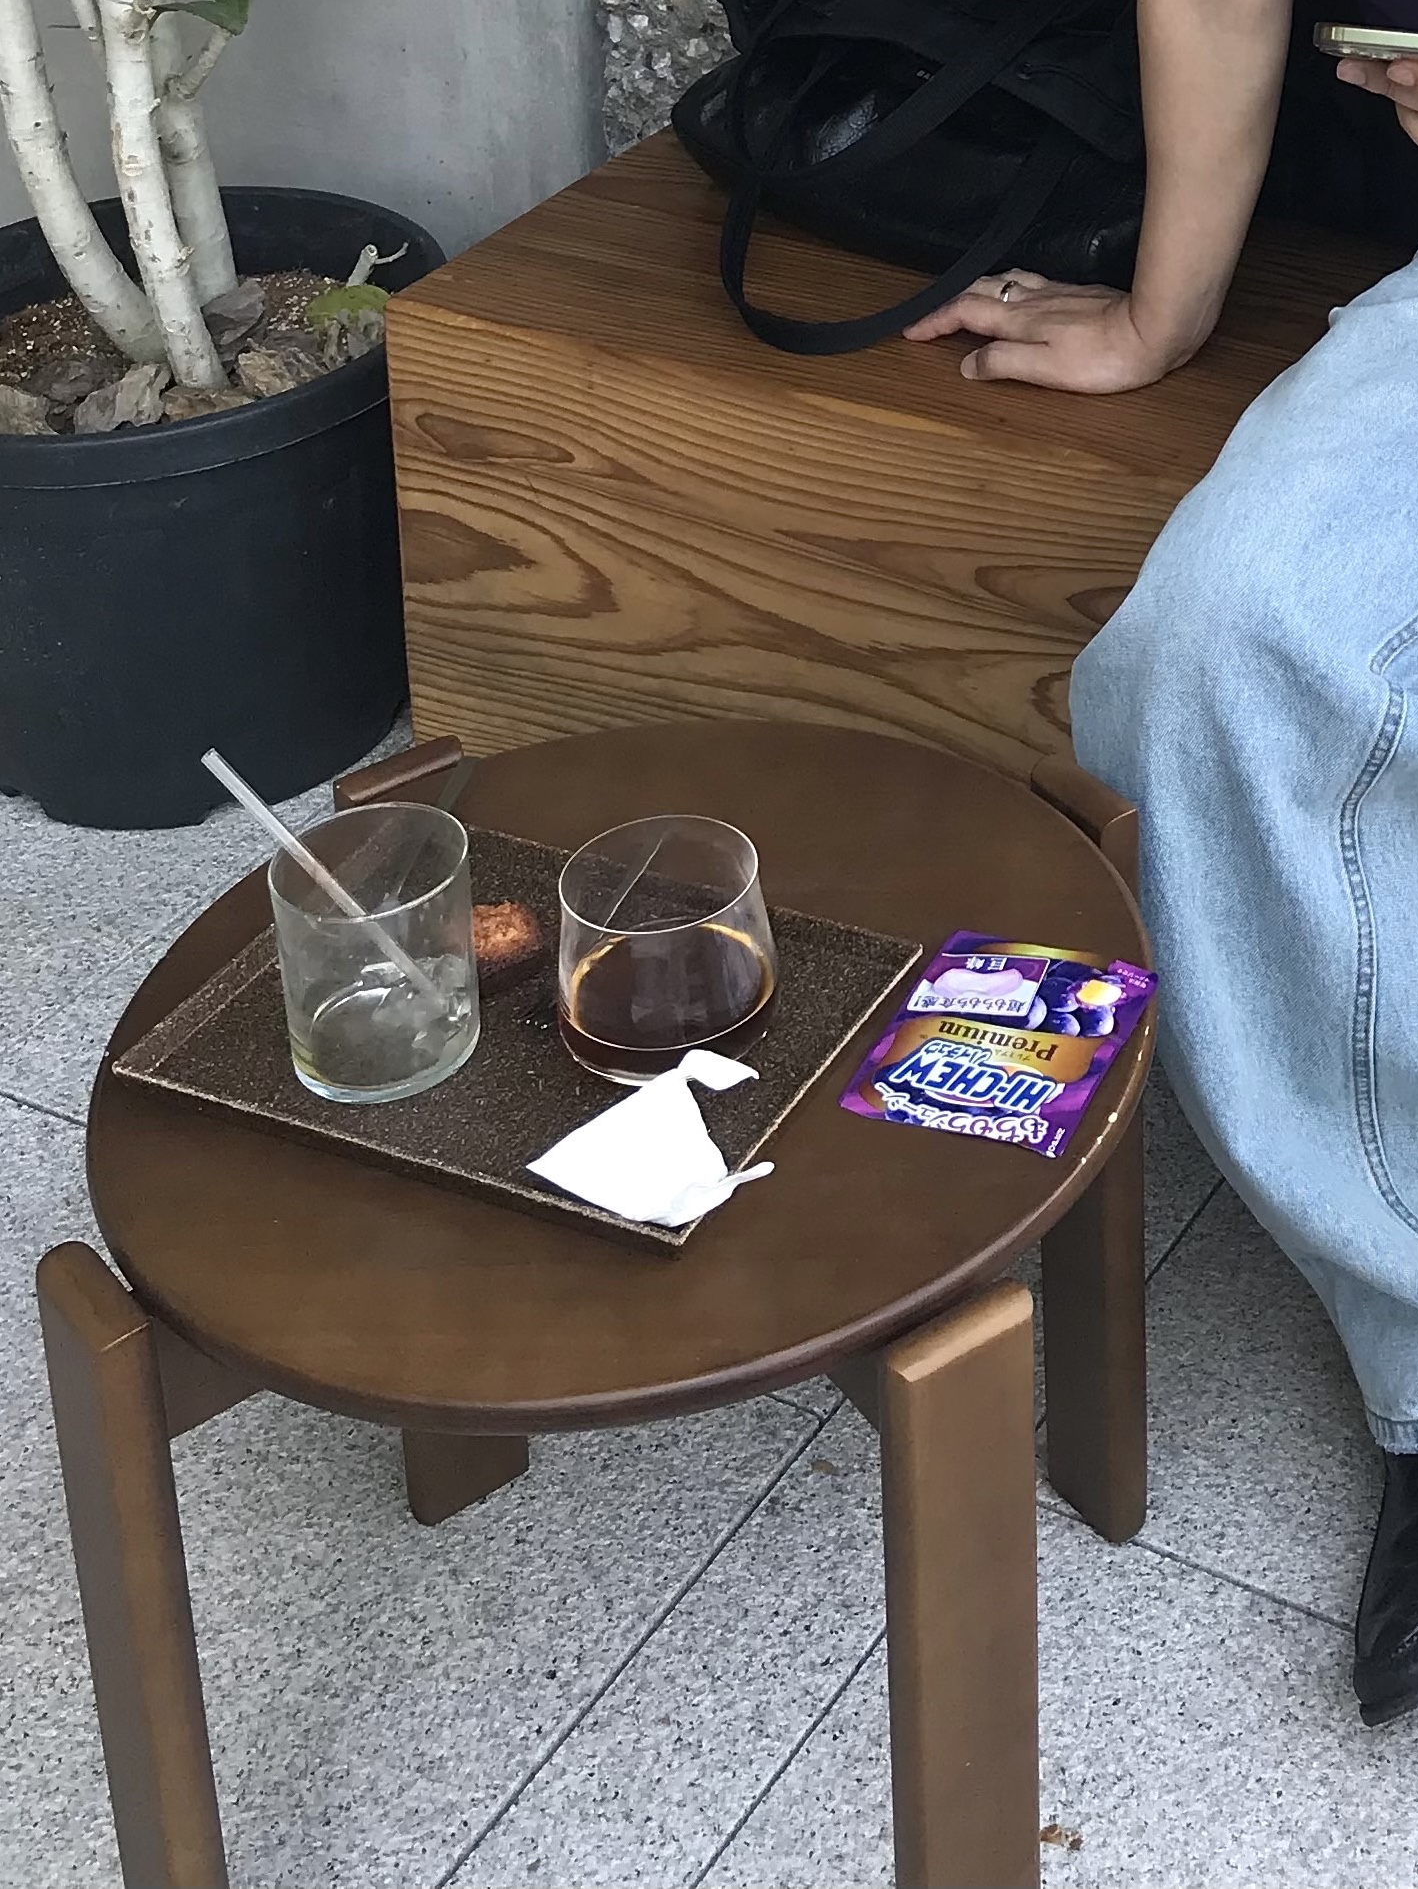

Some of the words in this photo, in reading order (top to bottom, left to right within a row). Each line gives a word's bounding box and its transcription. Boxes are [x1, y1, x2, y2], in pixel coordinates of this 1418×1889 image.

[923, 1042, 990, 1064] ハイチュウ
[938, 1020, 1059, 1061] Premium
[891, 1056, 1054, 1111] HI-CHEW
